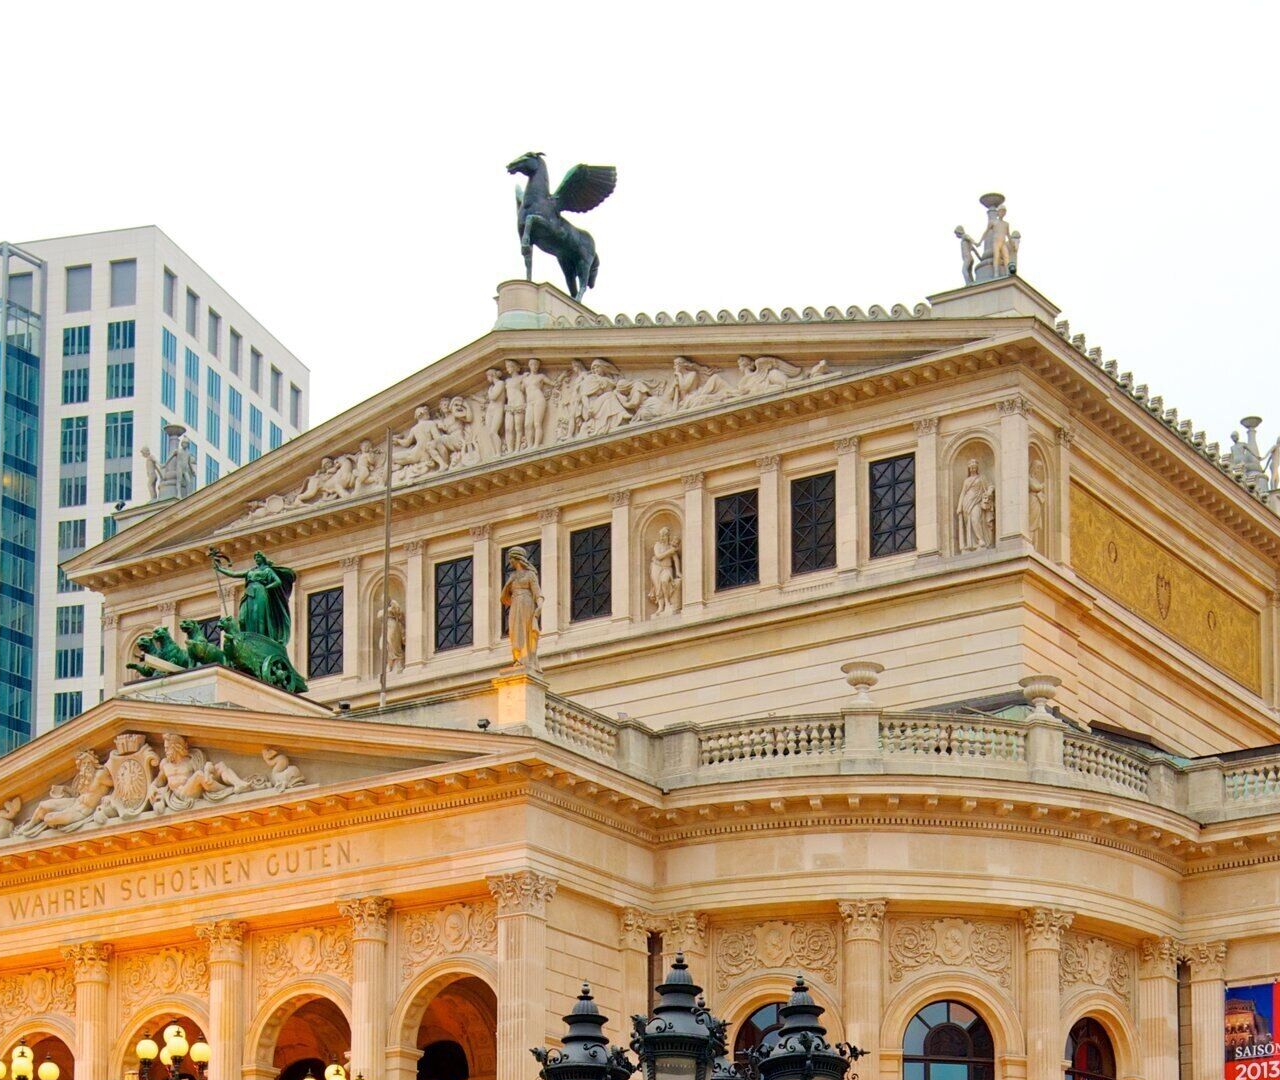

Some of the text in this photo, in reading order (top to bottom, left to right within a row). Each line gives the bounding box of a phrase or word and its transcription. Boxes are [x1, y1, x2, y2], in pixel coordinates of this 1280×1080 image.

[8, 882, 106, 921] WAHREN
[120, 858, 251, 901] SCHOENEN
[266, 839, 360, 877] GUTEN.
